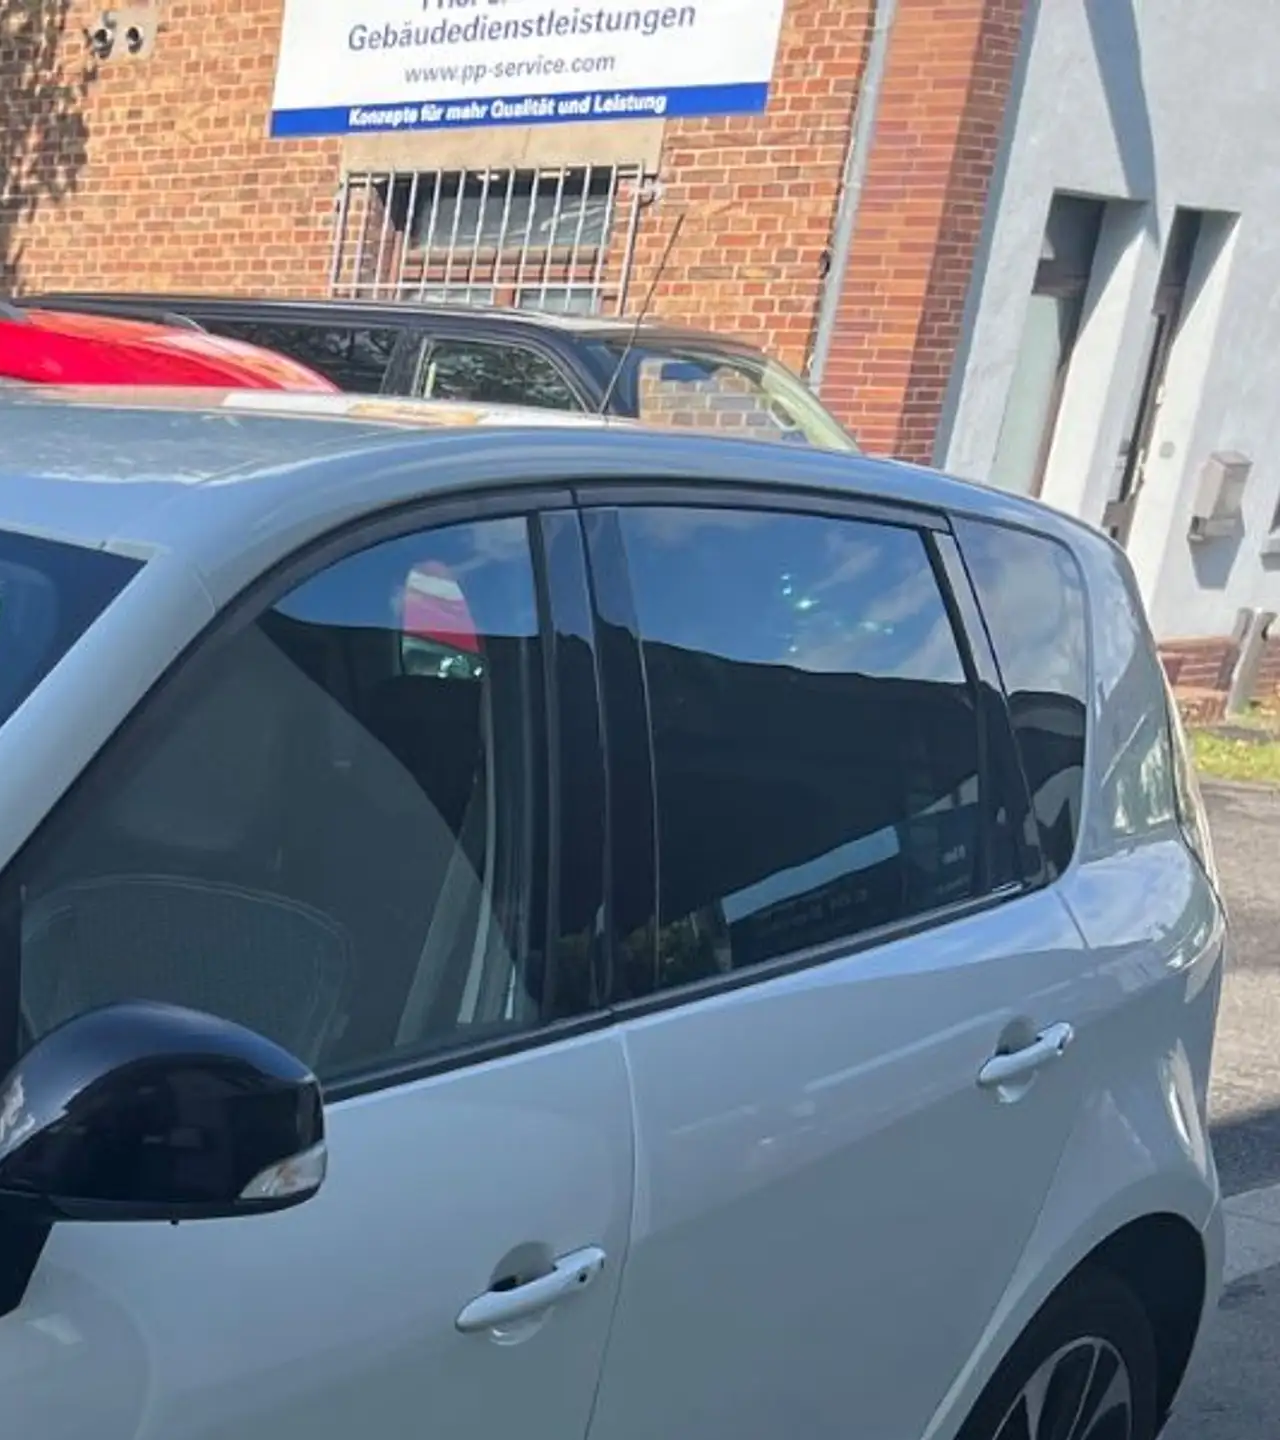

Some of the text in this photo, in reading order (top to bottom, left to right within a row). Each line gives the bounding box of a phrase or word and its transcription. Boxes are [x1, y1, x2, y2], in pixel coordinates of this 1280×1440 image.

[348, 4, 697, 51] Gebäudedienstleistungen
[404, 54, 616, 86] www.pp-service.com
[348, 92, 667, 128] Konzepte für mehr Qualität und Leistung
